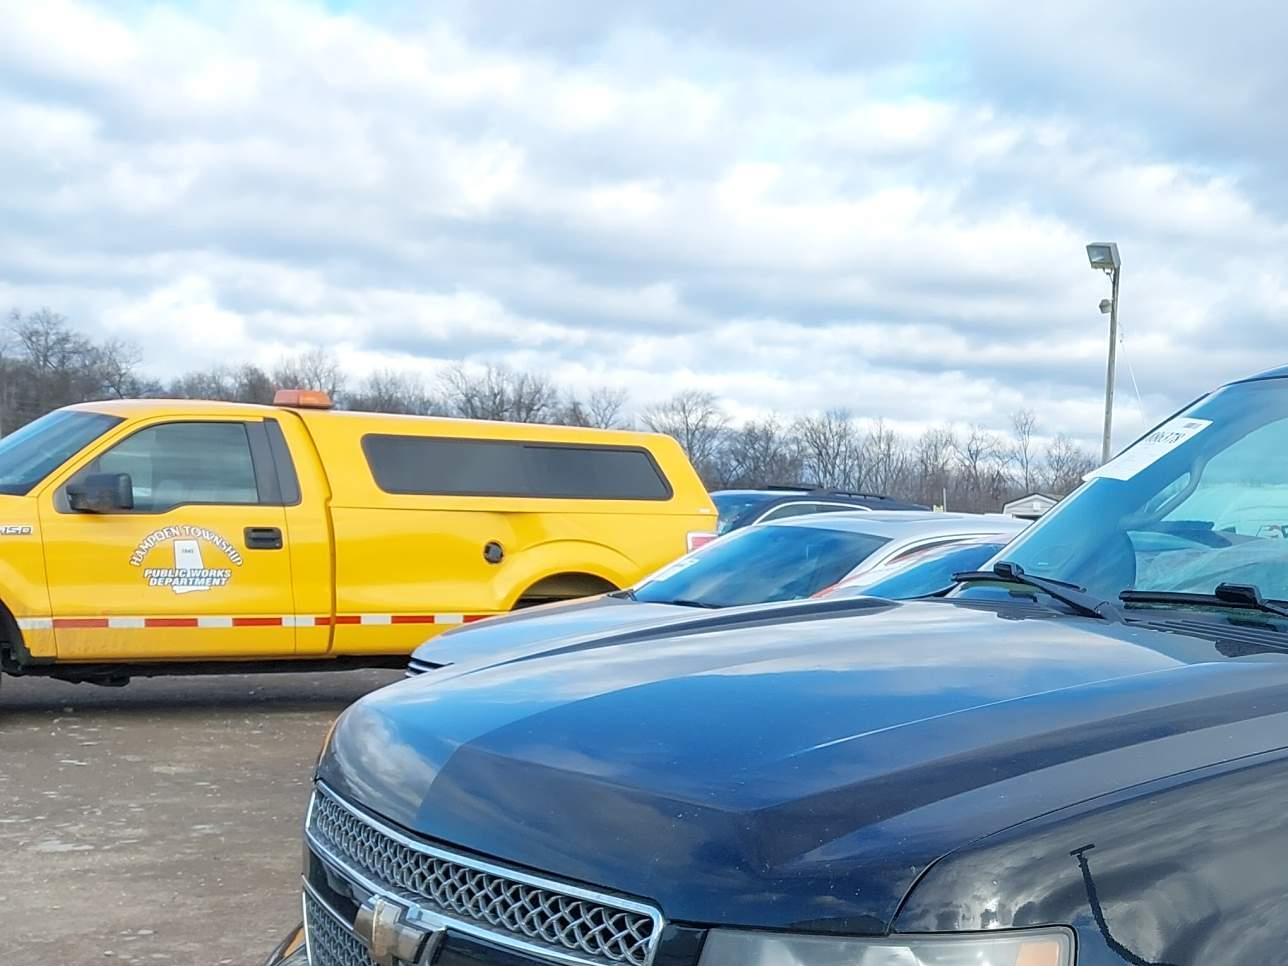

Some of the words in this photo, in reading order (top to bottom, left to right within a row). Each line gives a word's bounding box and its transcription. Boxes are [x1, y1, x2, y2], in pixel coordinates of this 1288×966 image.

[130, 526, 181, 566] HAMPDEN
[182, 526, 243, 567] TOWNSHIP
[144, 568, 187, 578] PUBLIC
[188, 569, 232, 578] WORKS
[149, 577, 227, 586] DEPARTMENT
